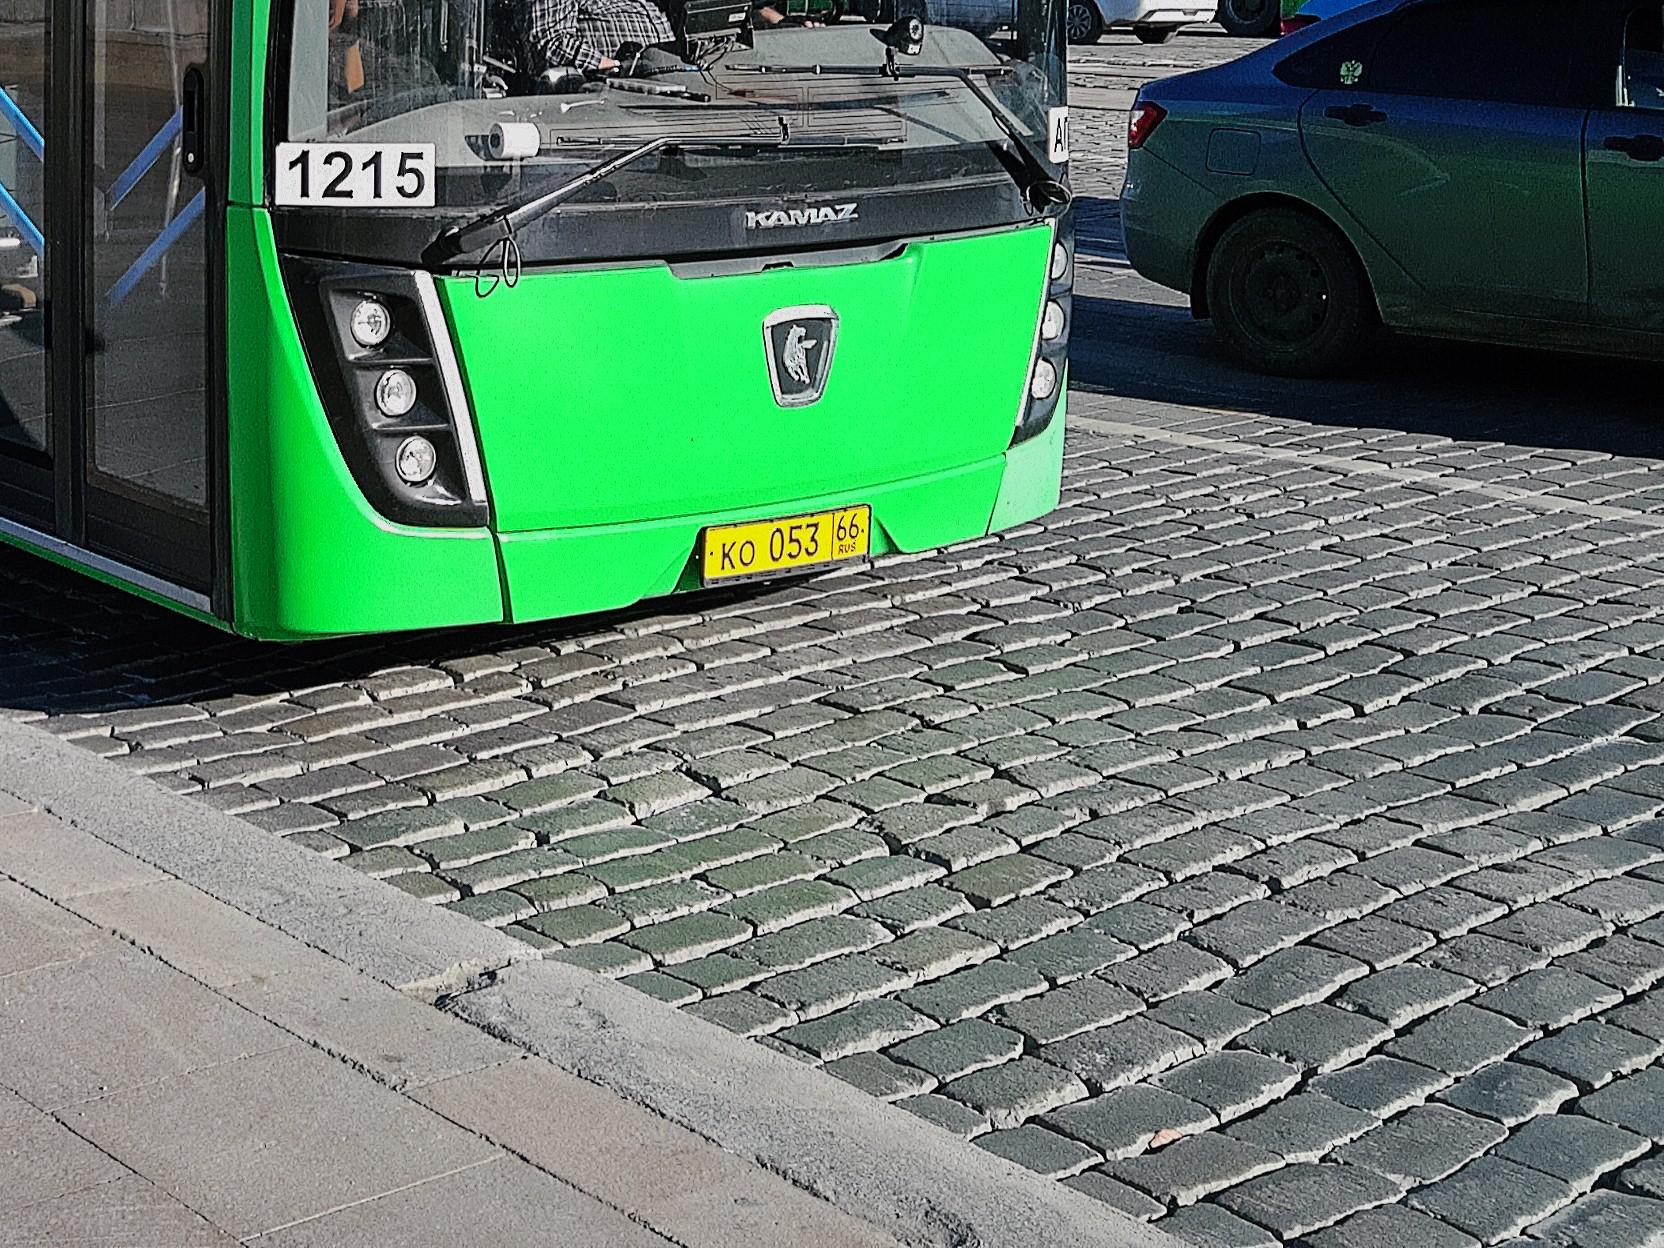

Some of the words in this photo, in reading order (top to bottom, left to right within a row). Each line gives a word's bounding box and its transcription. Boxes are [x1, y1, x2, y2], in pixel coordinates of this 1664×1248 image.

[289, 149, 425, 199] 1215
[744, 202, 859, 230] KAMAZ
[836, 513, 859, 541] 66
[769, 522, 820, 562] 053
[838, 543, 856, 555] RUS
